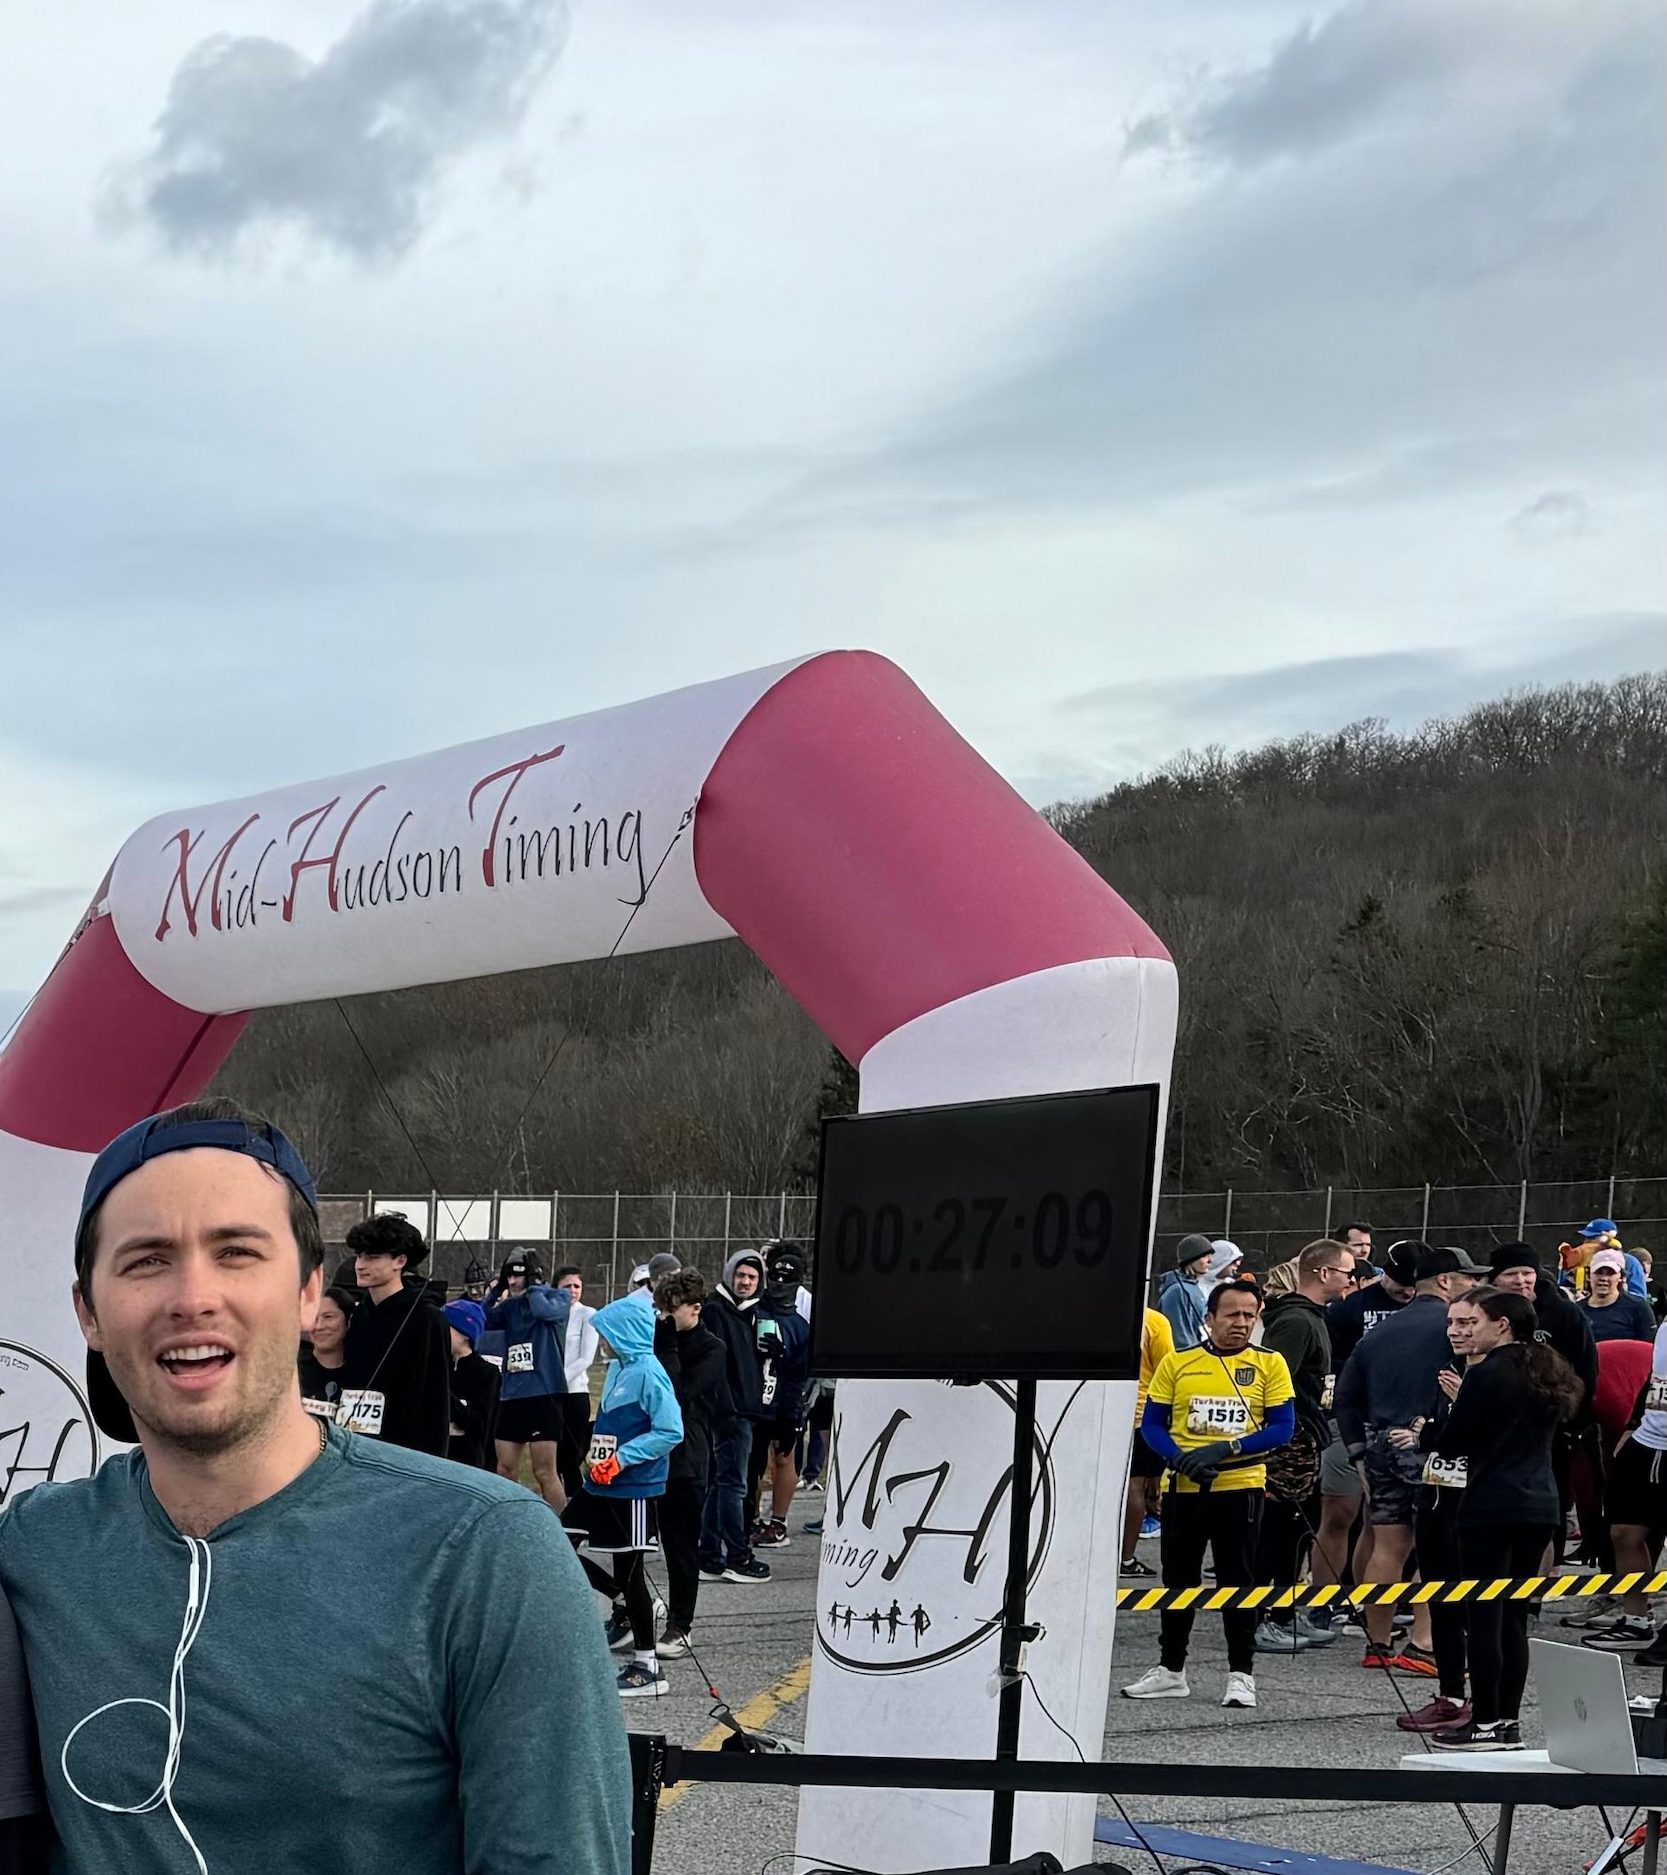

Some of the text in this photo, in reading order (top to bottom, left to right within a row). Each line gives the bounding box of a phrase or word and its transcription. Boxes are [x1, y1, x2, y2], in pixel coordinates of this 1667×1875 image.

[155, 744, 646, 942] Mid-Hudson Timing
[835, 1189, 1113, 1276] 00:27:09
[1208, 1408, 1246, 1423] 1513
